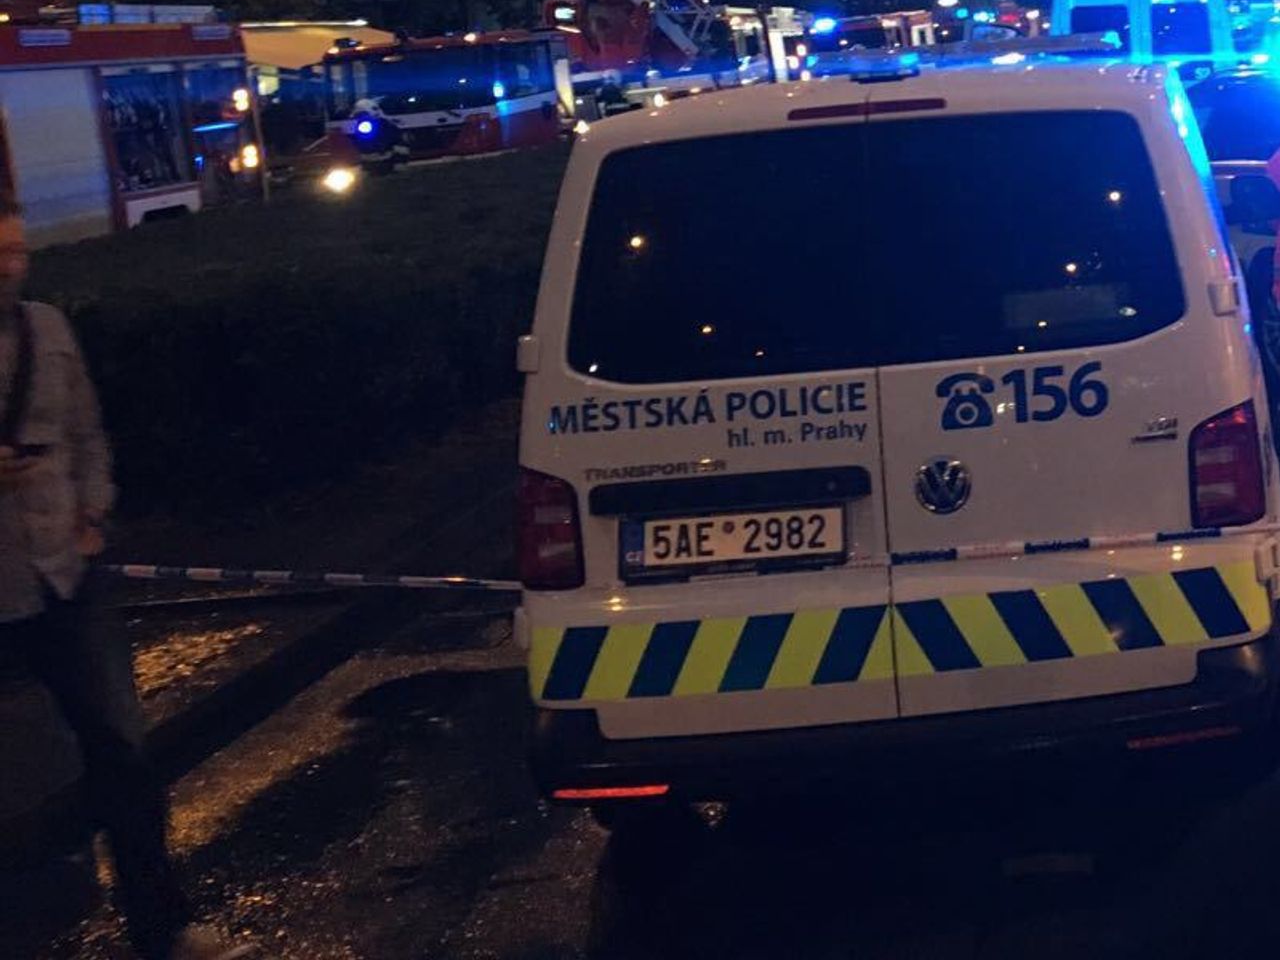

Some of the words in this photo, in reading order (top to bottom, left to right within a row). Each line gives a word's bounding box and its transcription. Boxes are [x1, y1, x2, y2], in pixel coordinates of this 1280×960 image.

[549, 389, 717, 435] MĚSTSKÁ
[724, 381, 868, 421] POLICIE
[1001, 361, 1109, 424] 156
[727, 428, 755, 448] hl.
[763, 431, 792, 446] m.
[801, 419, 867, 442] Prahy
[583, 459, 727, 482] TRANSPORTER
[652, 520, 715, 559] 5AE
[742, 513, 826, 554] 2982
